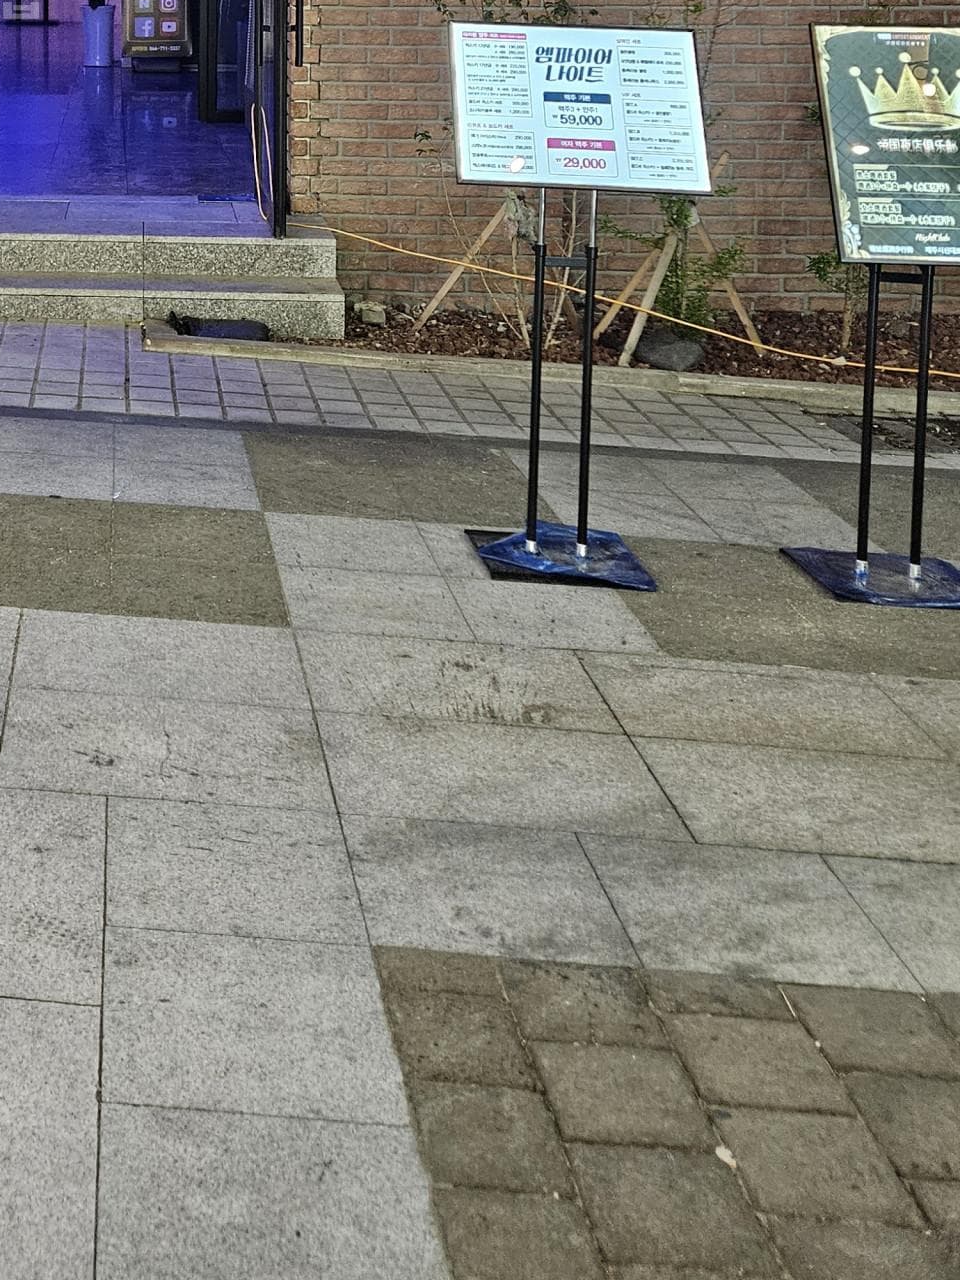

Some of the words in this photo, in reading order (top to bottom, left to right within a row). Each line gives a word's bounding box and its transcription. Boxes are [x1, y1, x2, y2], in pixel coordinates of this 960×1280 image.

[535, 46, 613, 65] 엠파이어
[545, 64, 604, 83] 나이트
[560, 114, 603, 126] 59,000
[563, 157, 607, 169] 29,000
